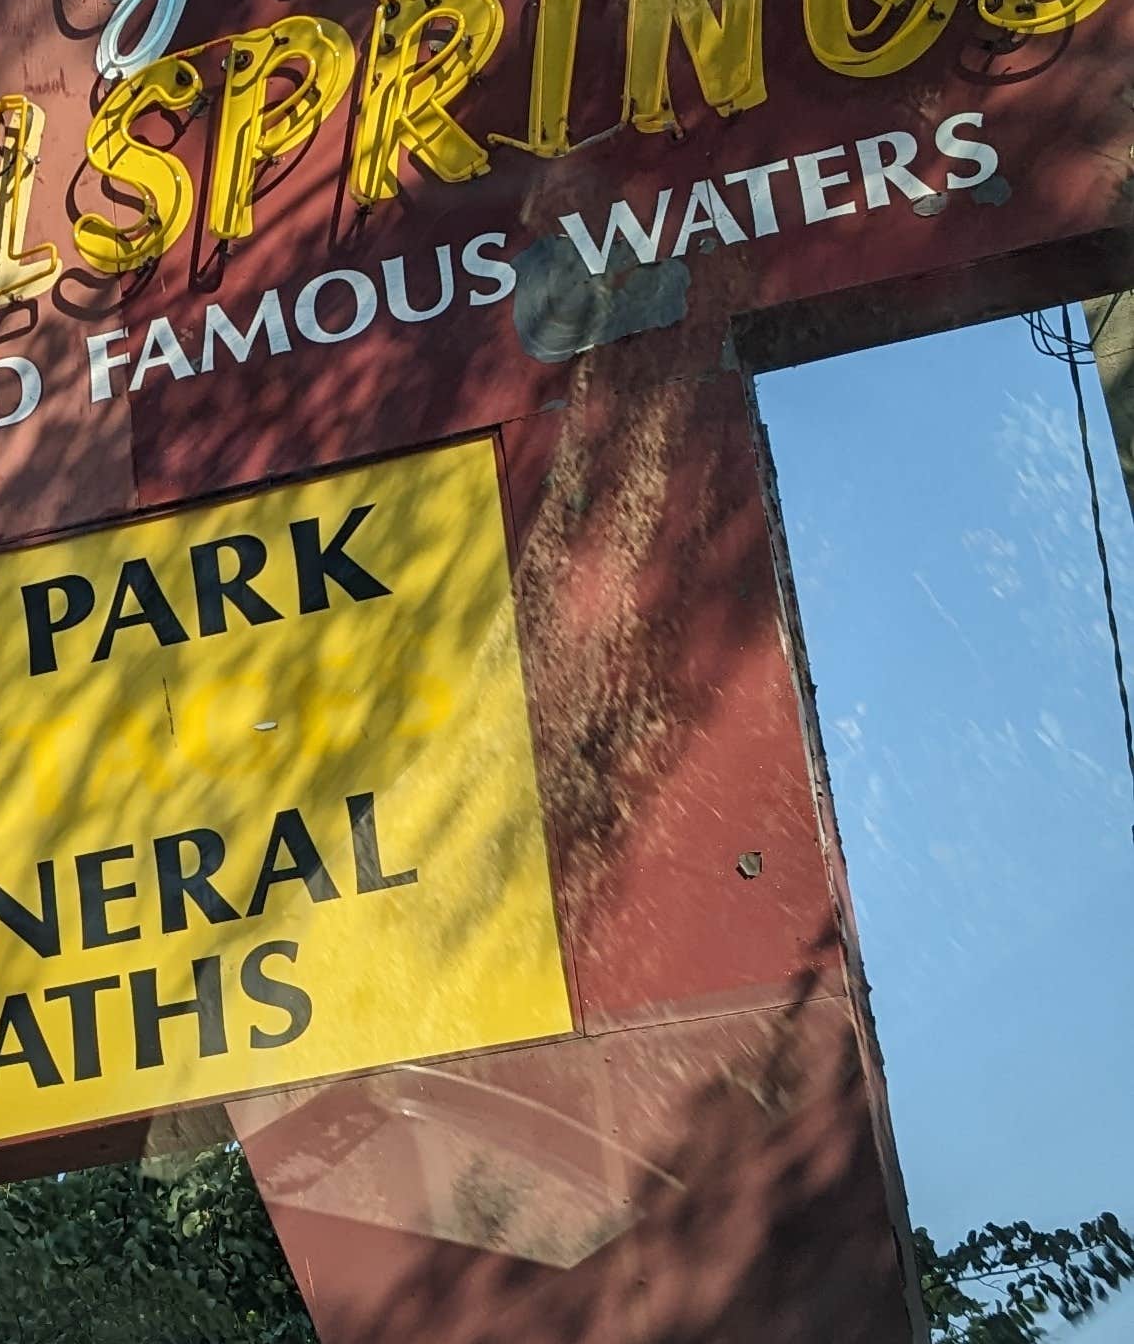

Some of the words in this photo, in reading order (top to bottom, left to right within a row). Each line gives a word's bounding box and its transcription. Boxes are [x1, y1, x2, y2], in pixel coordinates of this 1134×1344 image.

[86, 231, 518, 404] FAMOUS
[558, 112, 999, 276] WATERS
[21, 502, 392, 677] PARK
